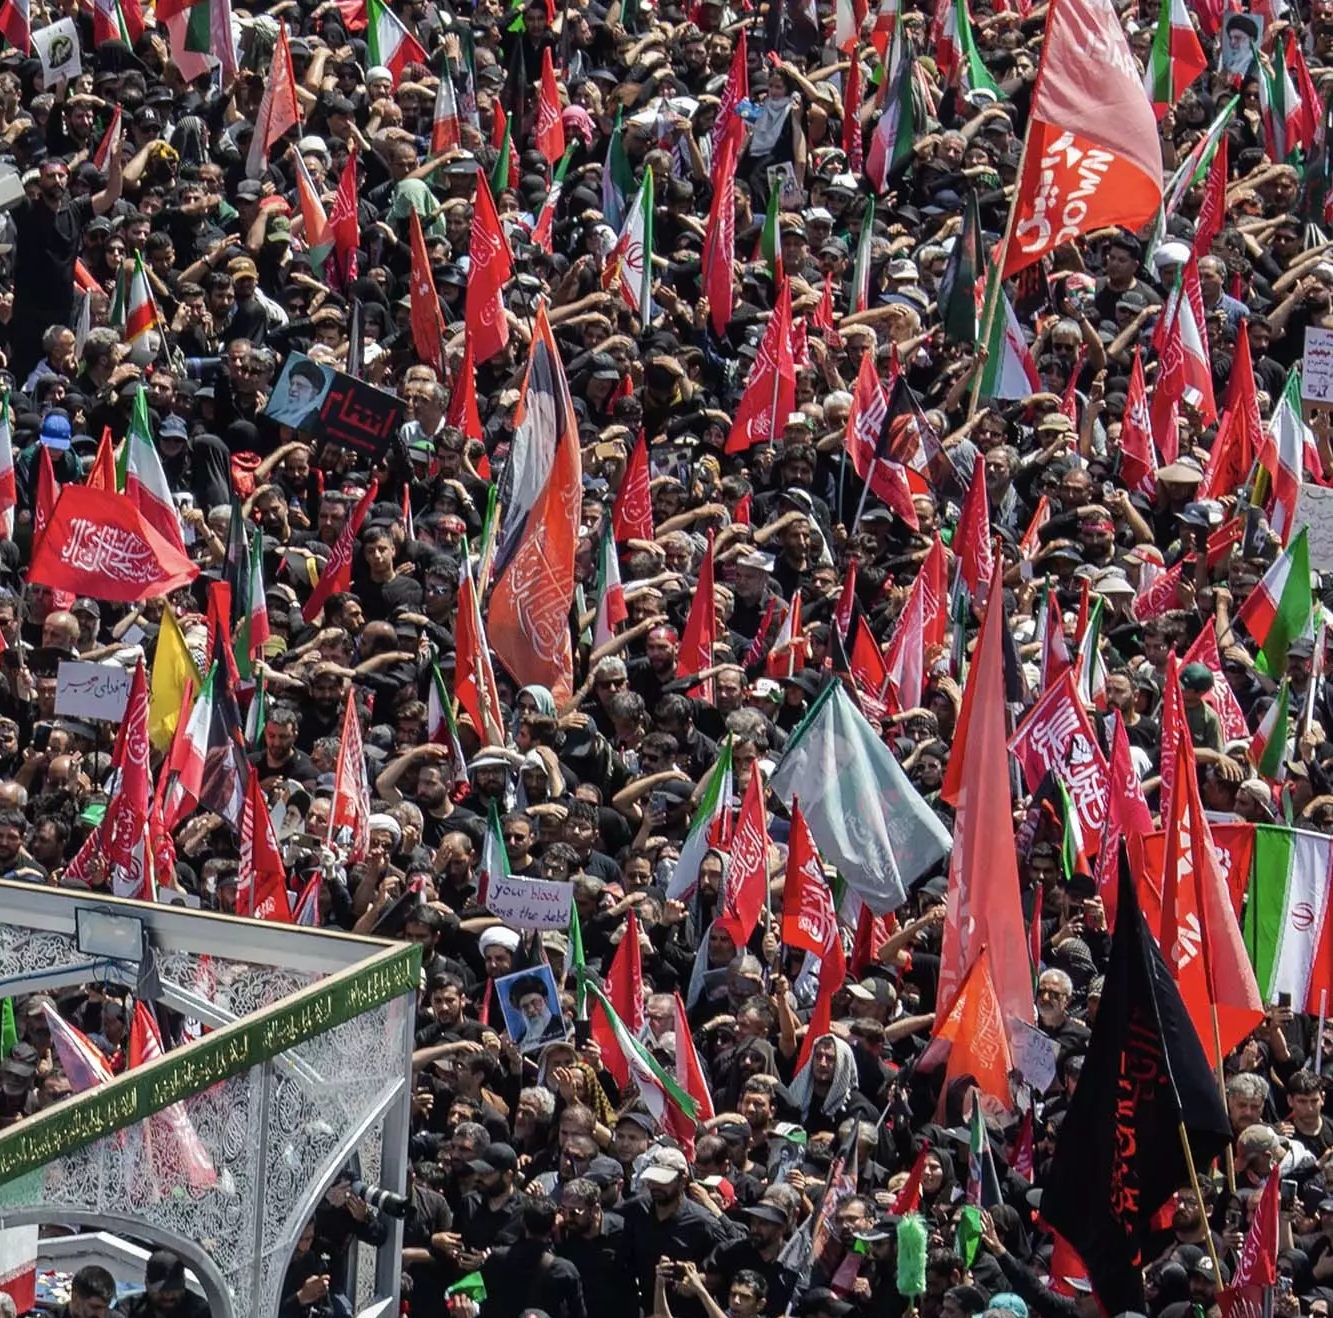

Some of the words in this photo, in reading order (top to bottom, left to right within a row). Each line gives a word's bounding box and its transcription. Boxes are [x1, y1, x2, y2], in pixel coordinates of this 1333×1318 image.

[319, 387, 398, 438] انتقام
[489, 883, 527, 900] your
[530, 885, 561, 902] blood
[519, 905, 538, 921] the
